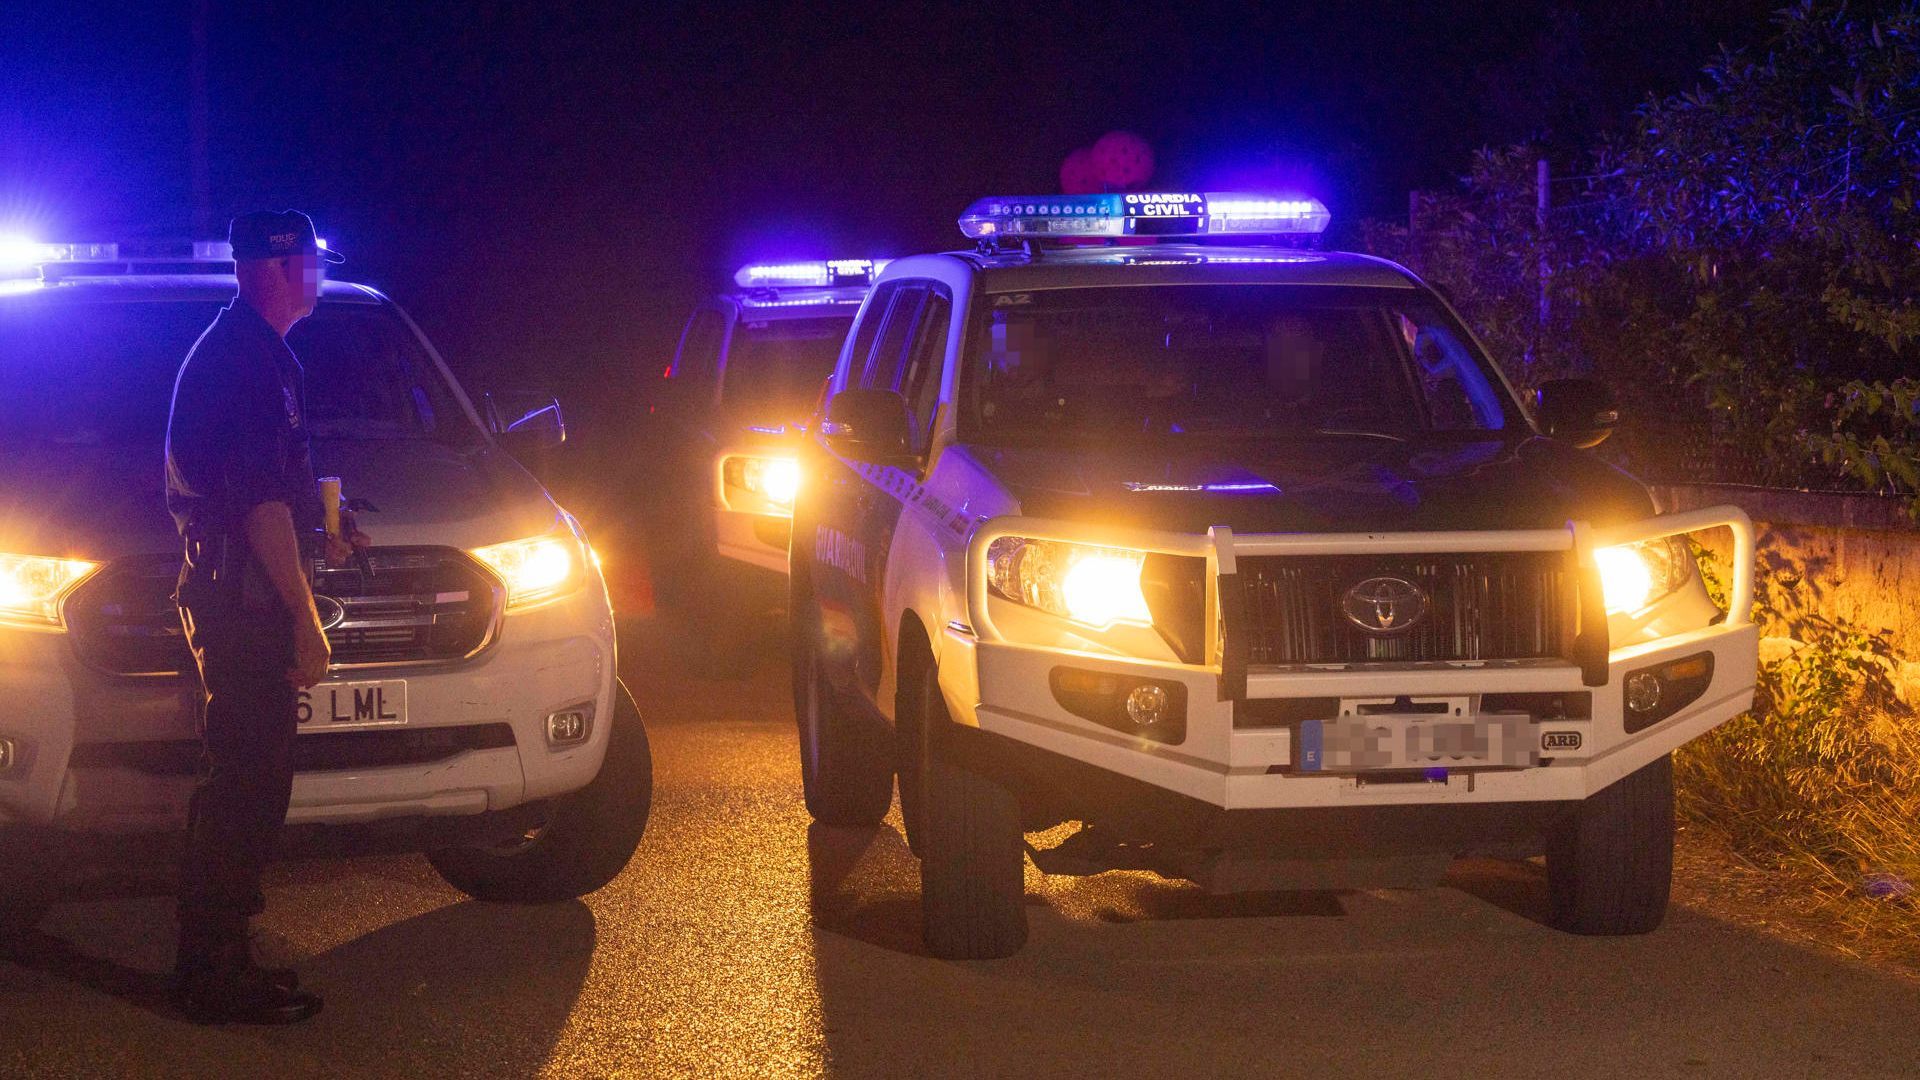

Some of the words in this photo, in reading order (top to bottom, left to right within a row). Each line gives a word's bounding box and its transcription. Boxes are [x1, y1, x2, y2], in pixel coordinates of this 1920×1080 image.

[1125, 194, 1203, 204] GUARDIA
[1143, 203, 1190, 216] CIVIL
[994, 294, 1032, 306] A2
[331, 687, 397, 722] LML
[1546, 735, 1578, 747] ARB
[1306, 751, 1315, 762] E
